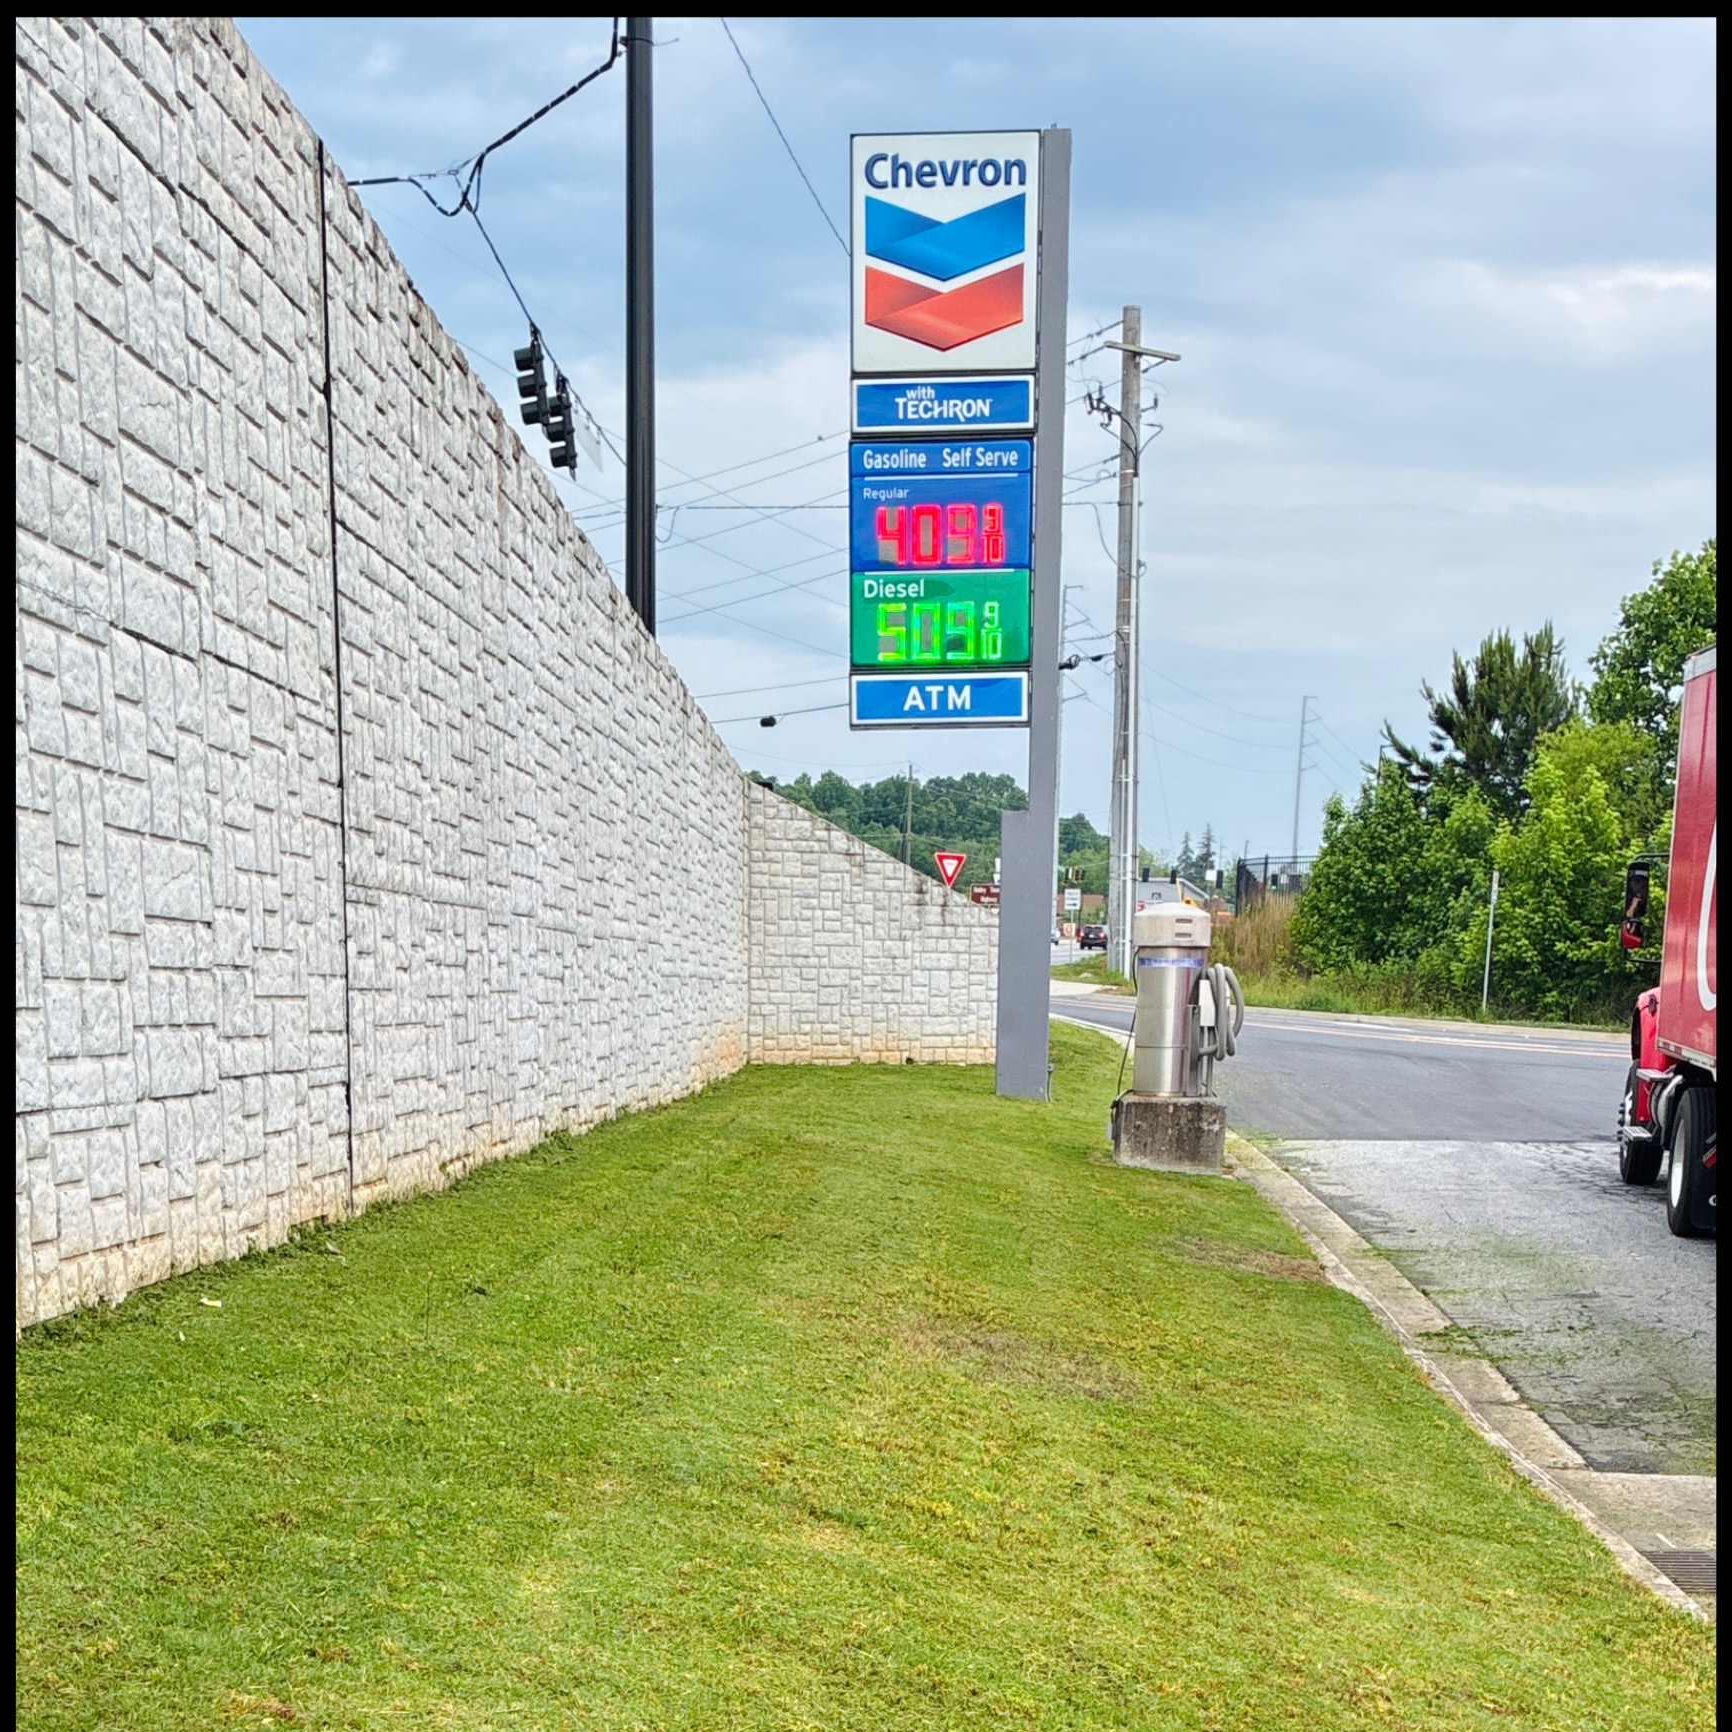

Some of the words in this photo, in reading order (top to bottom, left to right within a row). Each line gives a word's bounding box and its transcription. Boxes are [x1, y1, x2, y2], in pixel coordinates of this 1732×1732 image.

[864, 153, 1026, 189] Chevron
[906, 386, 935, 399] with
[895, 397, 992, 422] TECHRON
[863, 449, 927, 469] Gasoline
[942, 447, 971, 468] Self
[975, 447, 1018, 467] Serve
[863, 488, 909, 502] Regular
[877, 504, 976, 565] 409
[864, 578, 925, 598] Diesel
[877, 602, 974, 661] 509
[903, 685, 971, 711] ATM
